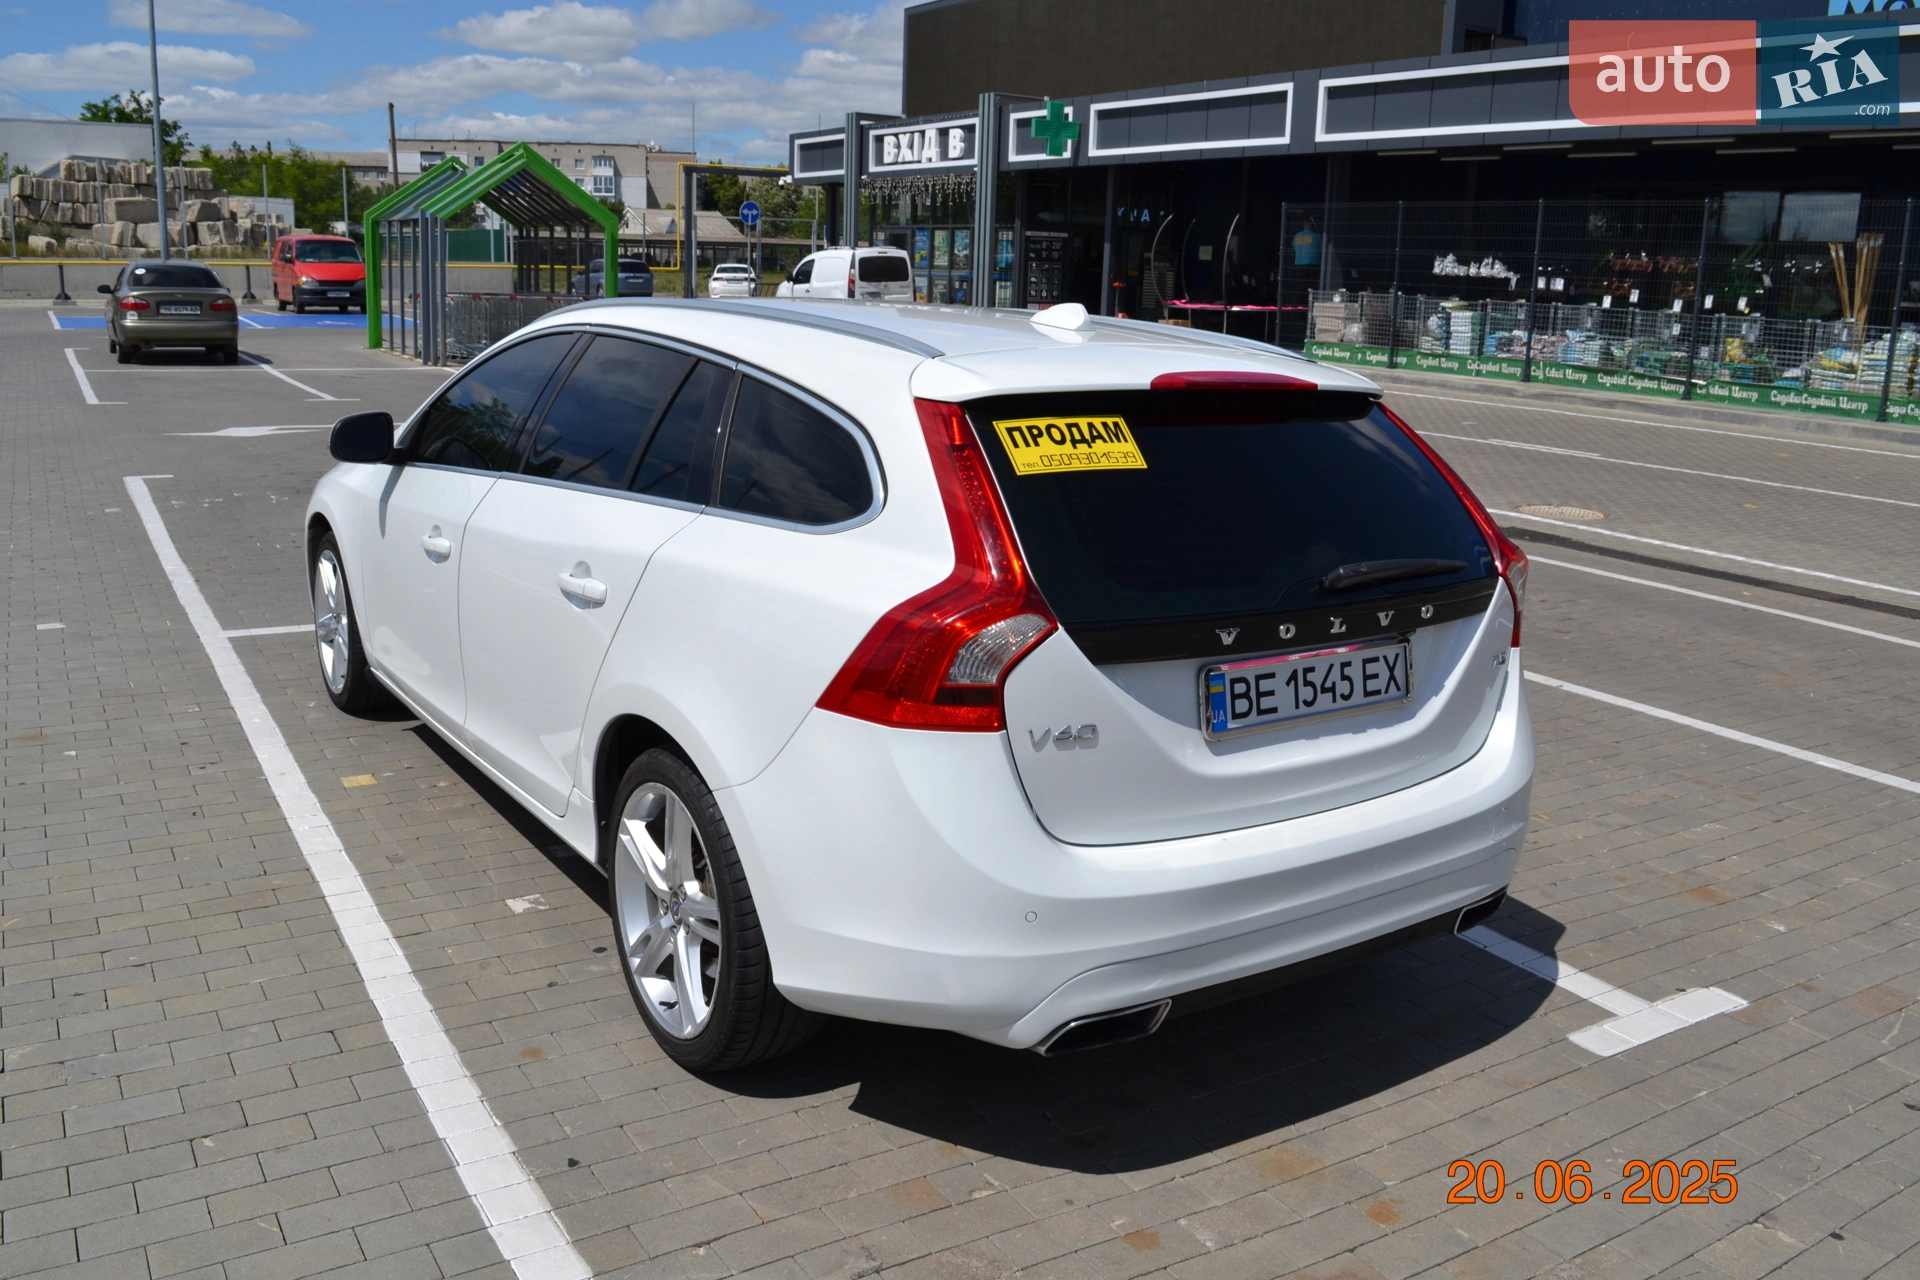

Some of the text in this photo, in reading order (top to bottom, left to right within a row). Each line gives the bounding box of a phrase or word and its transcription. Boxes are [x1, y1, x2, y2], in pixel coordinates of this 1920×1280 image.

[883, 128, 940, 164] ВХІД
[1440, 357, 1459, 371] Центр
[1501, 363, 1522, 377] Центр
[1566, 368, 1588, 384] Центр
[1731, 385, 1759, 403] Центр
[1801, 393, 1869, 414] Садовий Центр
[1005, 421, 1129, 449] ПРОДАМ
[1216, 604, 1434, 645] VOLVO
[1229, 652, 1402, 721] BE 1545 EX
[1211, 710, 1227, 724] UA
[1027, 723, 1099, 753] V60
